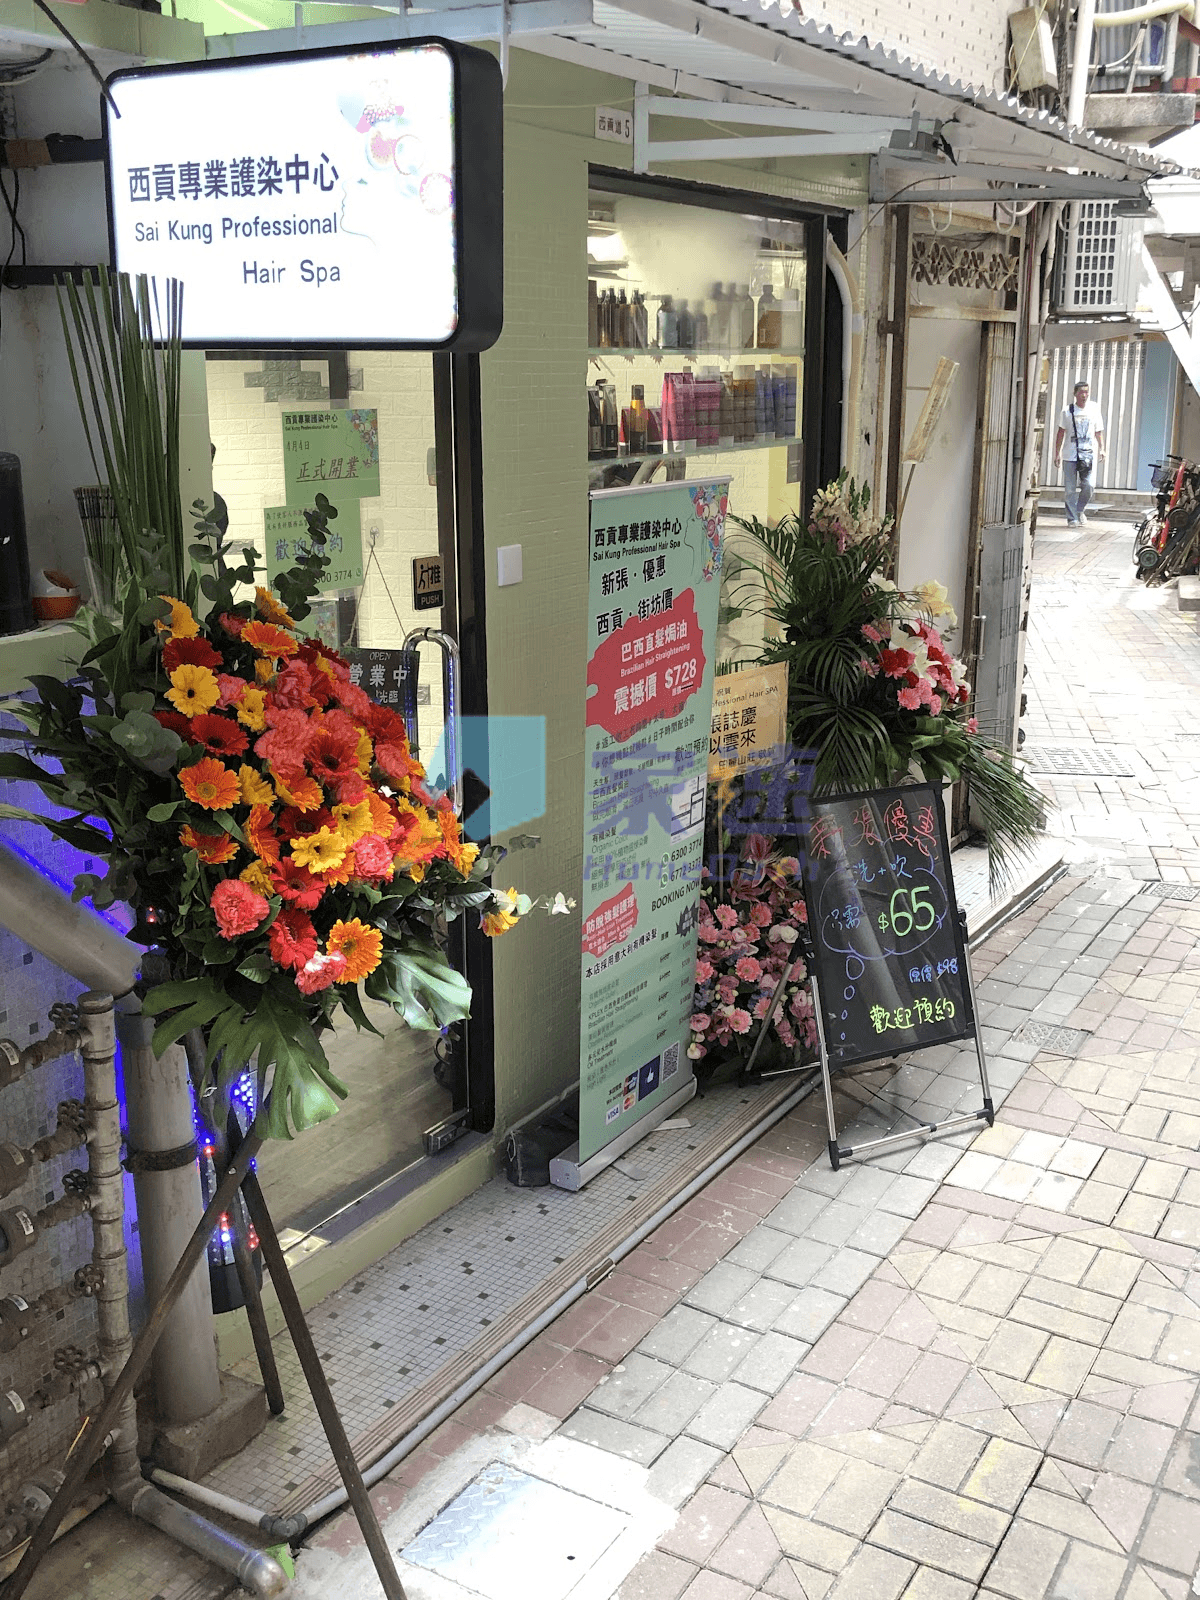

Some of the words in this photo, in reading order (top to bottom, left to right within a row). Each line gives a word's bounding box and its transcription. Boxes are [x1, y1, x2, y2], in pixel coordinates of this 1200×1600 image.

[624, 119, 630, 138] 5
[127, 152, 340, 202] 西貢專業護染中心
[135, 221, 159, 242] Sai
[168, 219, 213, 245] Kung
[222, 212, 338, 238] Professional
[242, 260, 286, 284] Hair
[300, 259, 341, 288] Spa
[297, 456, 359, 480] 正式開業
[595, 518, 682, 547] 西貢專業護染中心
[593, 550, 604, 561] Sai
[605, 549, 621, 560] Kung
[622, 543, 657, 557] Professional
[658, 541, 669, 551] Hair
[670, 539, 681, 550] Spa
[334, 570, 352, 582] 3774
[421, 594, 440, 606] PUSH
[369, 651, 392, 660] OPEN
[349, 663, 411, 689] 營業中
[614, 672, 657, 715] 震撼價
[665, 658, 697, 689] $728
[749, 689, 764, 699] Hair
[671, 845, 687, 862] 6300
[670, 867, 686, 882] 6772
[651, 886, 685, 912] BOOKING
[878, 885, 936, 937] $65
[869, 997, 956, 1035] 歡迎預約
[608, 1107, 619, 1120] VISA
